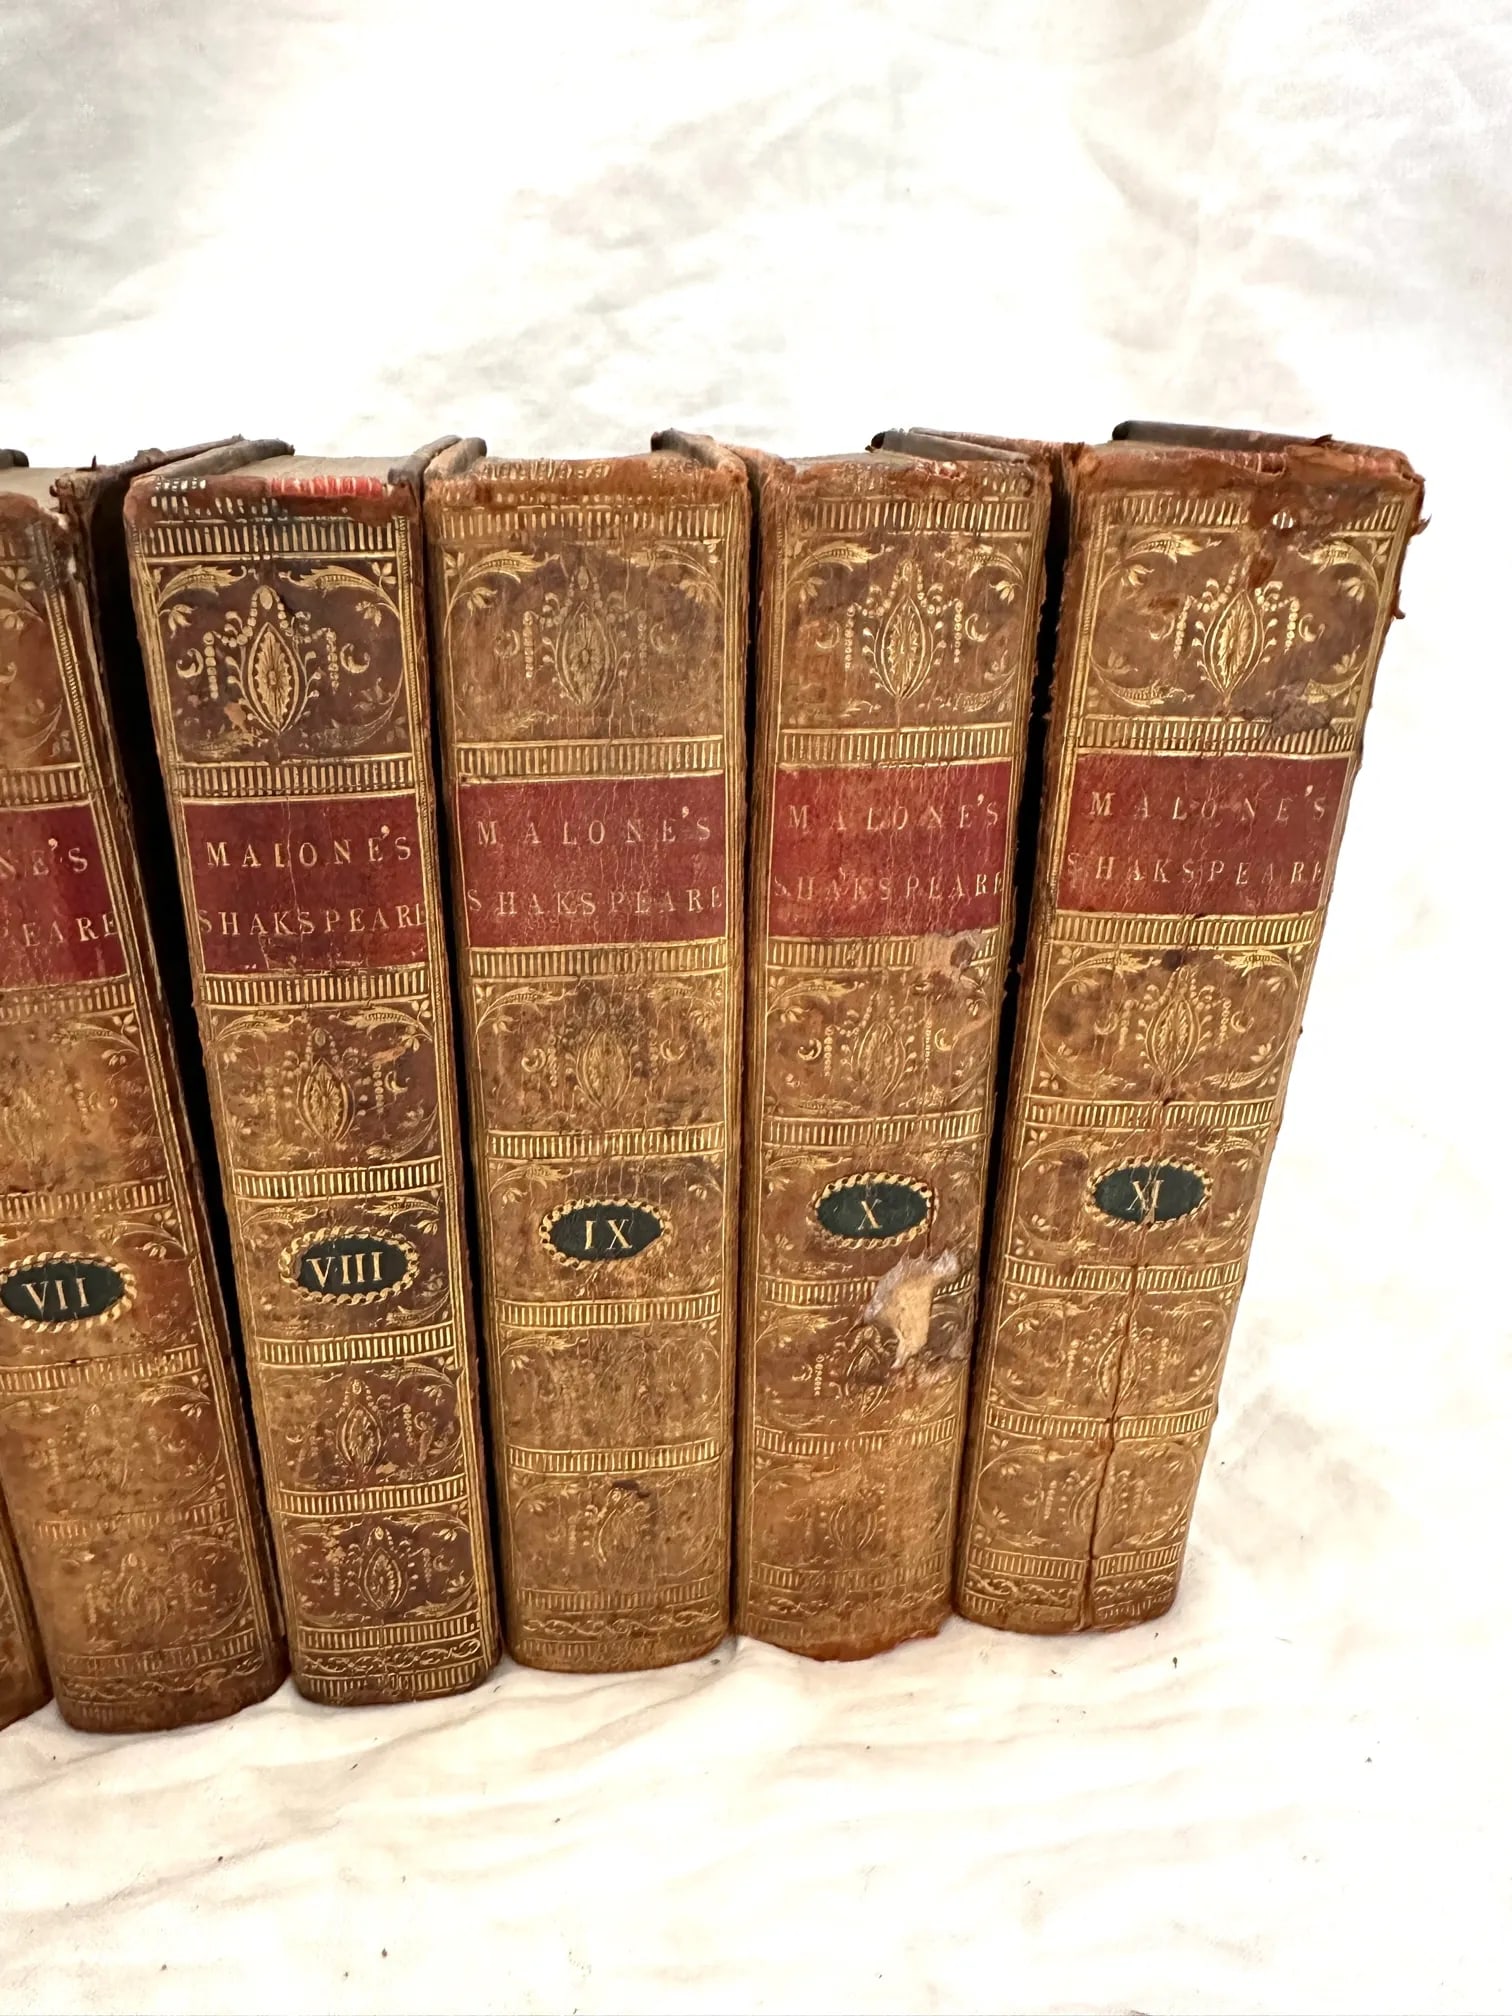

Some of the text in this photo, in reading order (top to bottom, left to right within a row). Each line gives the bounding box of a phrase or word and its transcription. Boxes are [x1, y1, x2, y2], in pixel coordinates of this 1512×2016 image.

[787, 793, 999, 832] MALONE'S
[1090, 785, 1327, 820] MALONE'S
[477, 805, 711, 845] MALONE'S
[206, 825, 412, 868] MALONE'S
[467, 885, 723, 915] SHAKSPEARE
[1125, 1179, 1165, 1211] XI
[857, 1198, 884, 1231] X
[584, 1218, 633, 1251] IX
[306, 1250, 384, 1288] VIII
[22, 1276, 91, 1314] VII
